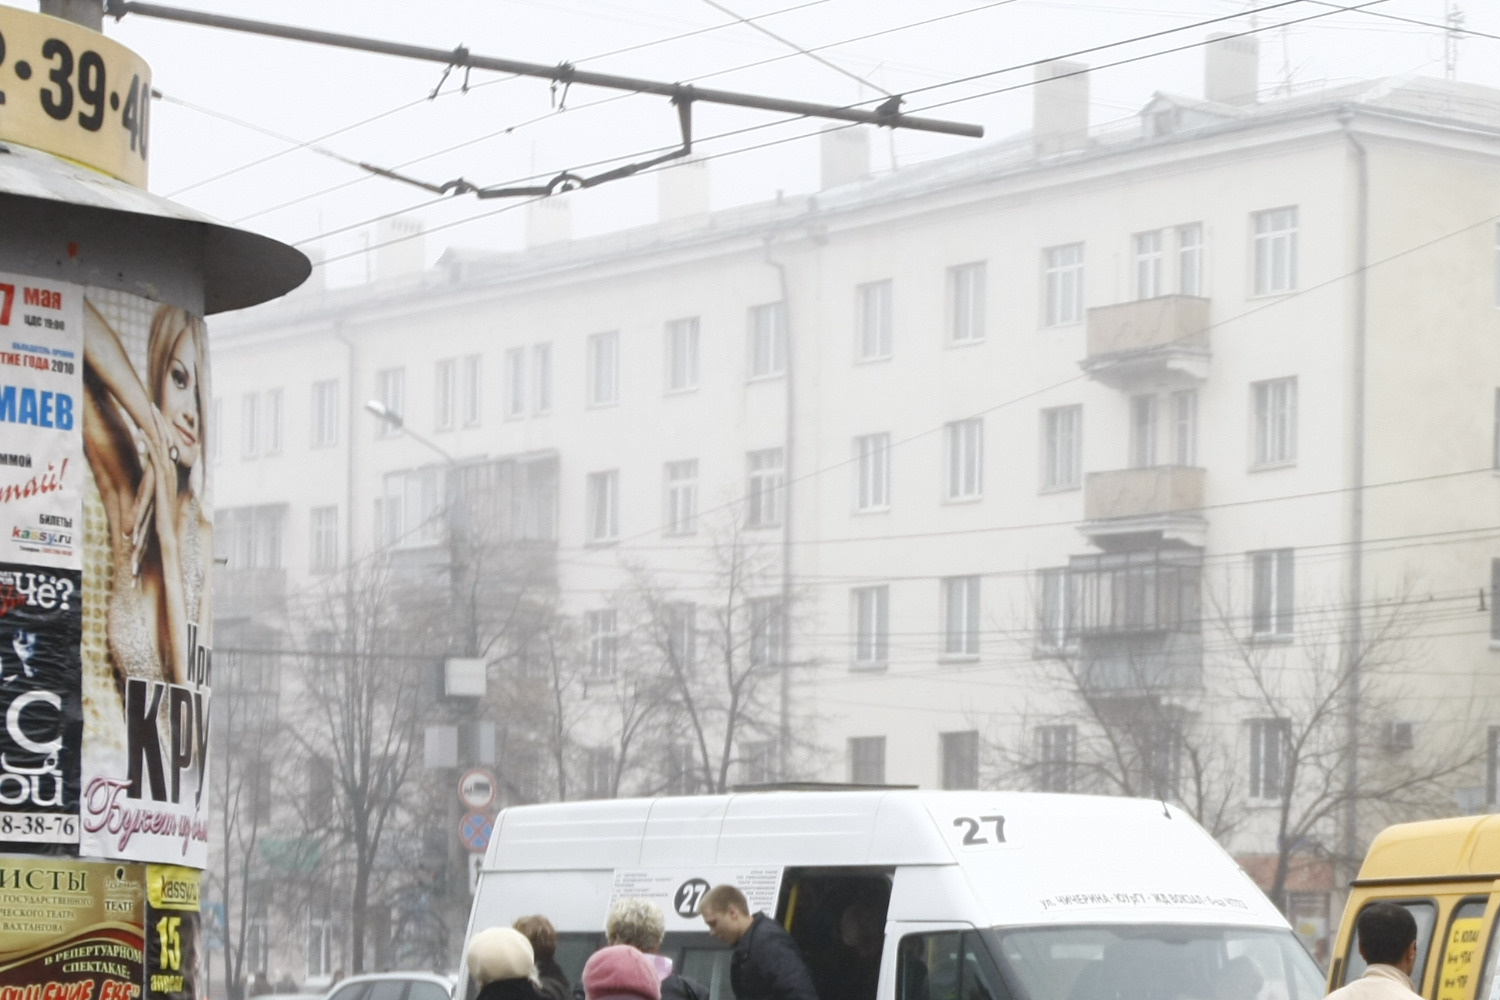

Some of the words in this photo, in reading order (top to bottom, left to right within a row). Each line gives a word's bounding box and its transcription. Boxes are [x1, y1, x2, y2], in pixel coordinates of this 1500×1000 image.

[23, 355, 49, 370] ГОДА
[51, 360, 75, 374] 2010
[39, 513, 73, 528] БИЛЕТЫ
[12, 526, 71, 544] kassy.ru
[953, 815, 1006, 847] 27
[678, 883, 706, 914] 27
[3, 922, 63, 932] ВАХТАНГОВА
[156, 916, 181, 971] 15
[55, 944, 142, 964] РЕПЕРТУАРНОМ
[62, 961, 130, 979] СПЕКТАКЛЕ:
